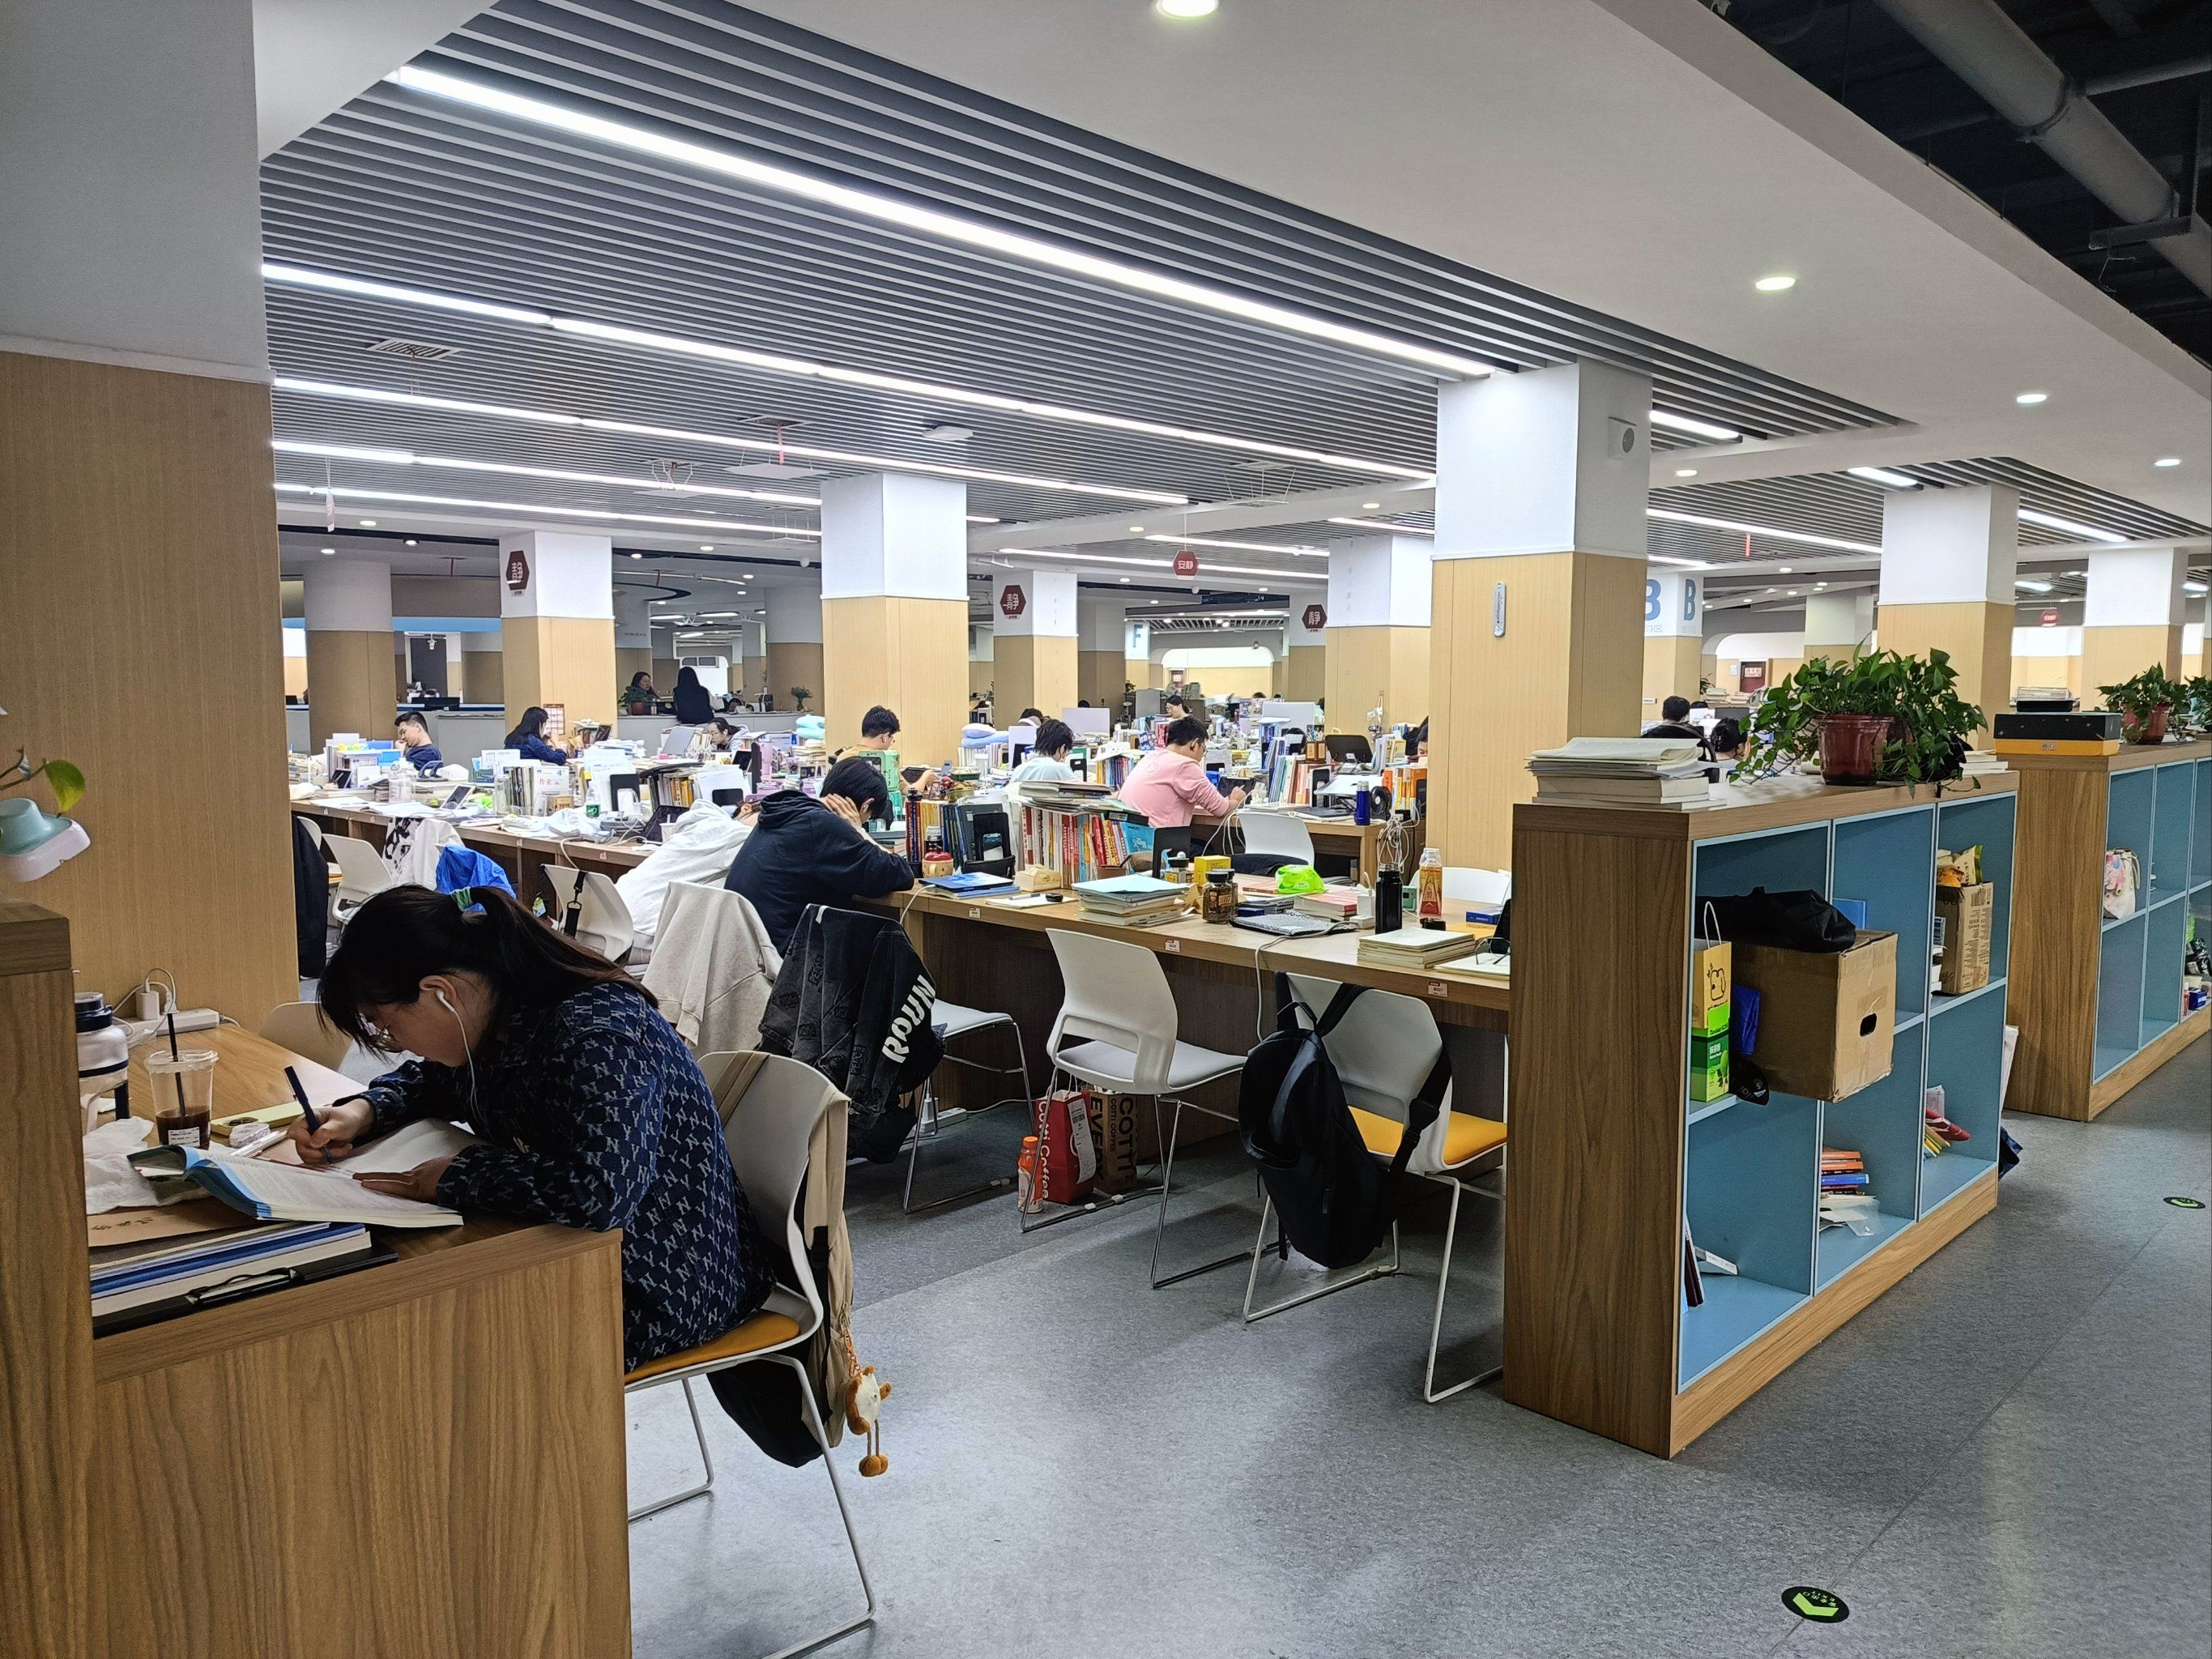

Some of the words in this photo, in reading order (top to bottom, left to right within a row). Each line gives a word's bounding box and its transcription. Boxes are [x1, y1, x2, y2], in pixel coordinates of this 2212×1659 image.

[1007, 593, 1019, 610] 静
[1684, 578, 1696, 621] B
[1308, 611, 1320, 625] 静
[1133, 624, 1143, 648] F
[1118, 1097, 1134, 1171] COTTI
